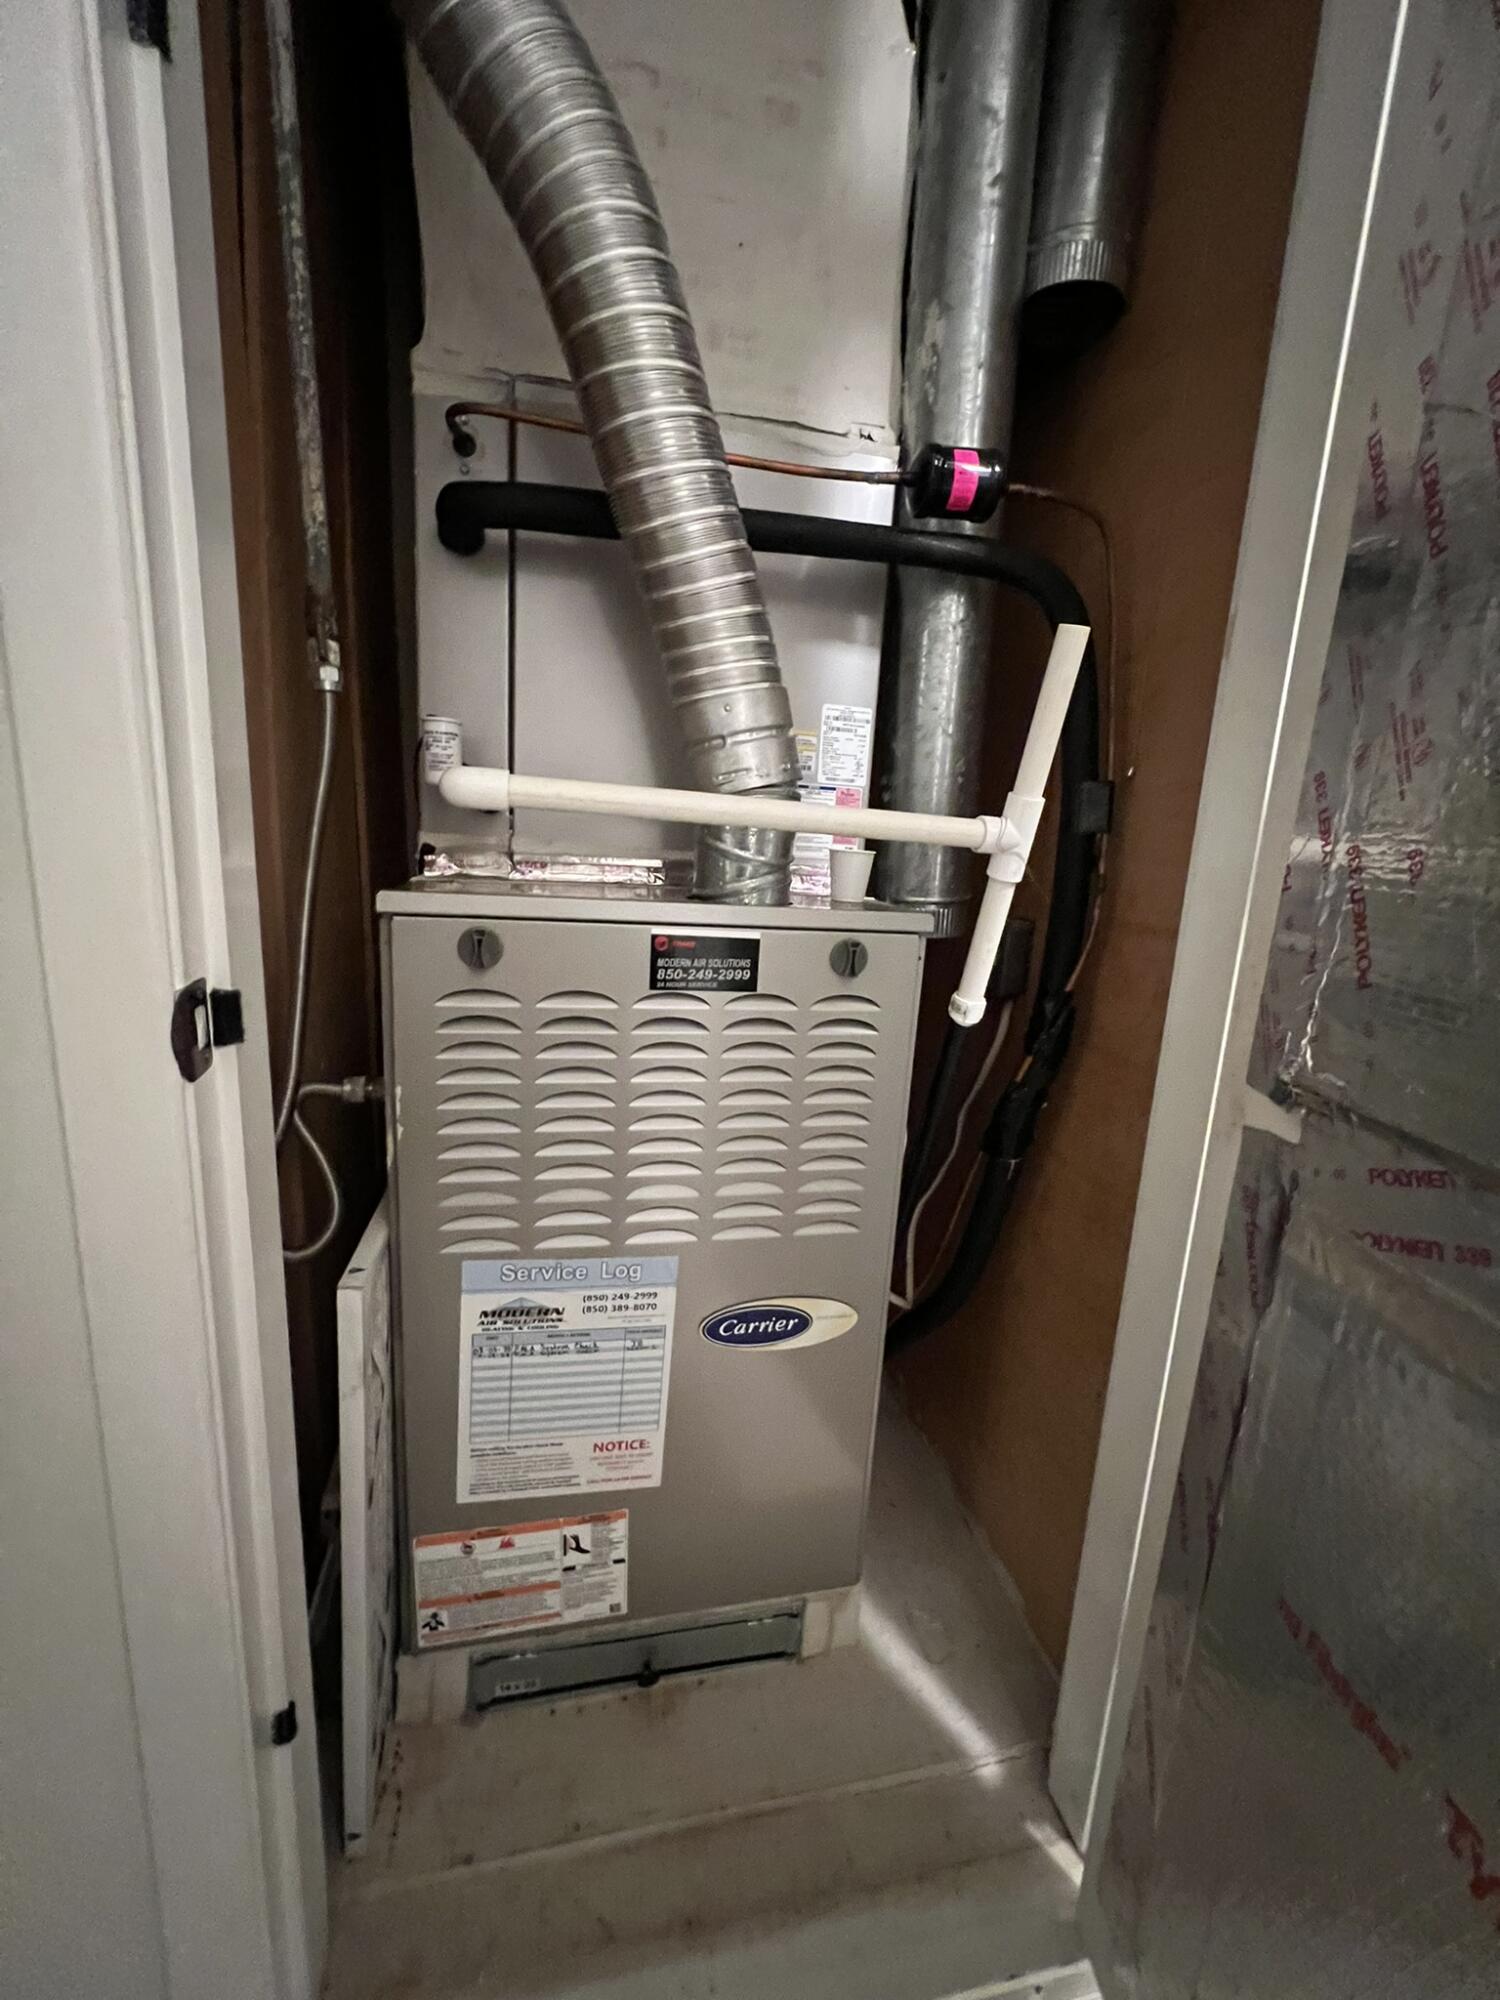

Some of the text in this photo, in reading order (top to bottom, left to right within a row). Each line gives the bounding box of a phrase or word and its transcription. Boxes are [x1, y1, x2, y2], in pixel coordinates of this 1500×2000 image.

[656, 957, 752, 968] MODERN AIR SOLUTIONS
[656, 968, 751, 980] 850-249-2999
[500, 1261, 641, 1281] Service Log
[582, 1292, 658, 1303] (850) 249-2999
[479, 1306, 565, 1319] MODERN
[582, 1302, 657, 1315] (850) 389-8070
[718, 1316, 799, 1336] Carrier
[593, 1438, 651, 1453] NOTICE:
